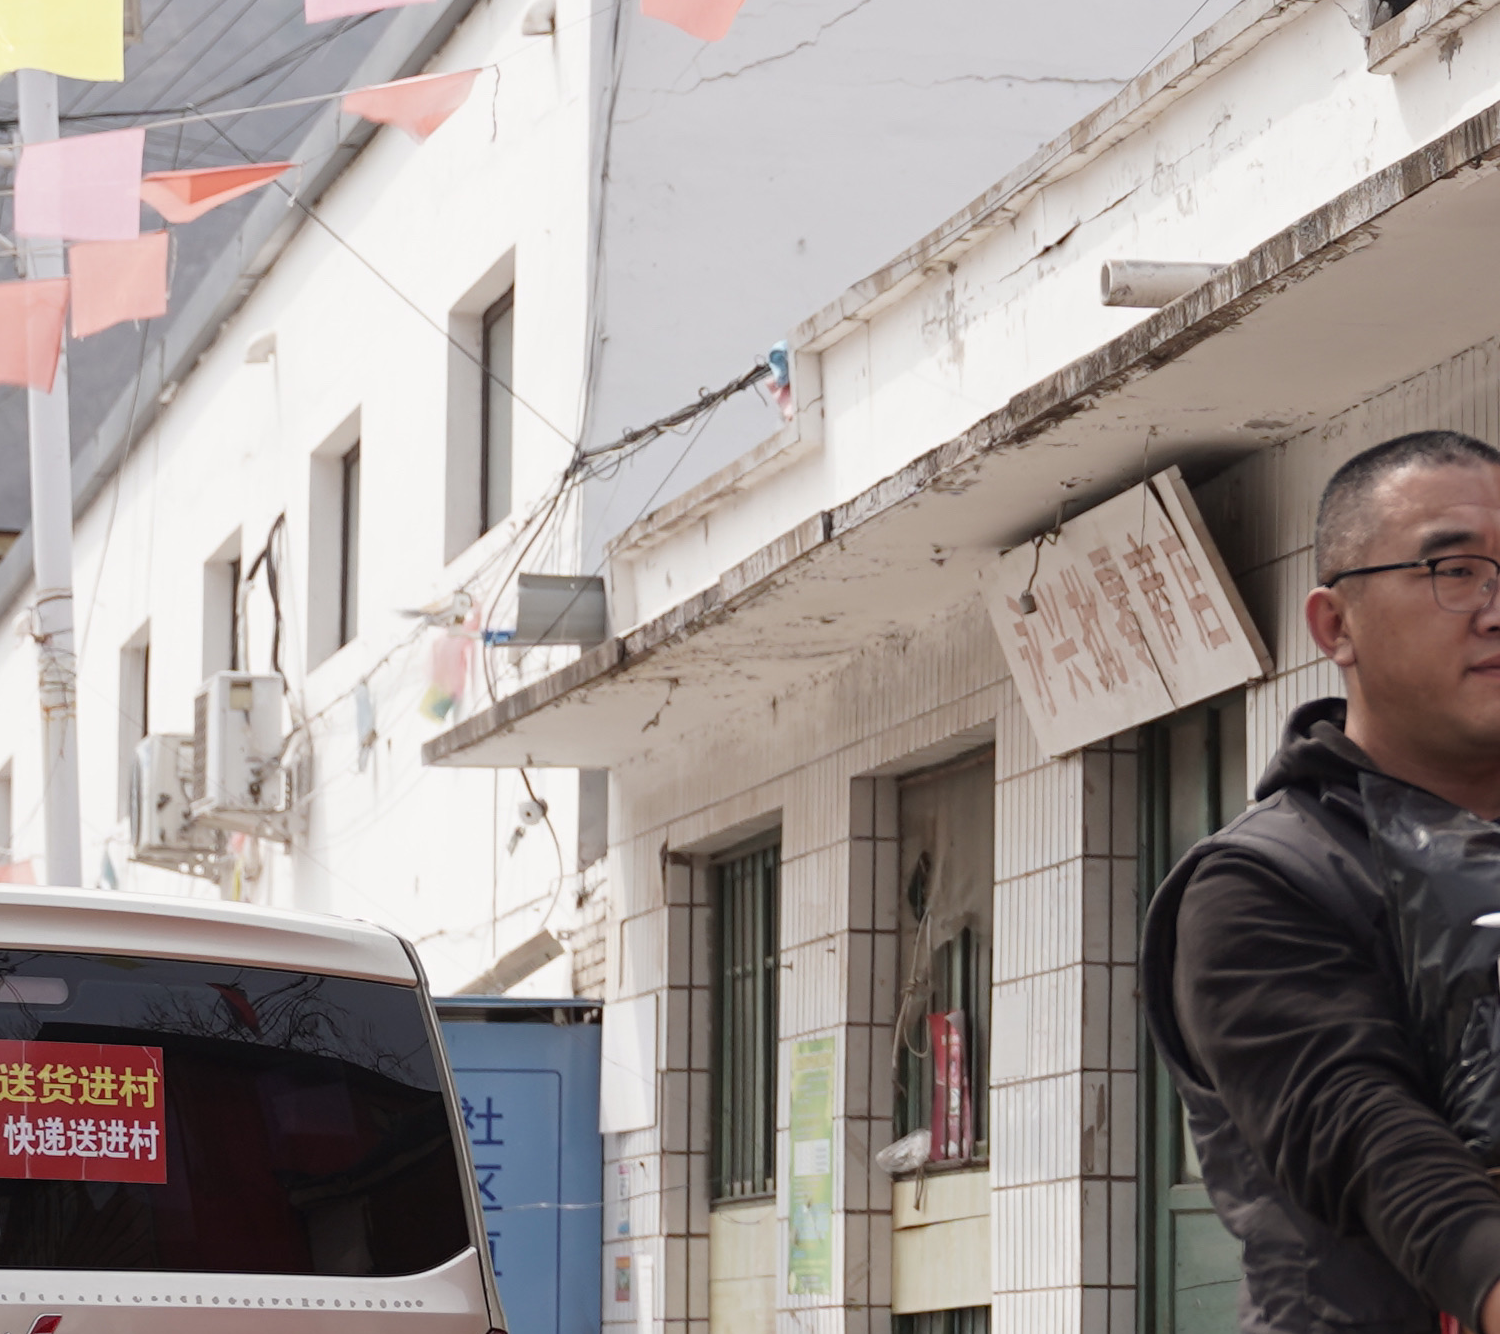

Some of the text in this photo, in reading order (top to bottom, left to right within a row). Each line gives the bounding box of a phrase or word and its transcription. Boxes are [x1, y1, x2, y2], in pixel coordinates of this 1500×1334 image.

[4, 1115, 160, 1161] 快递送进村
